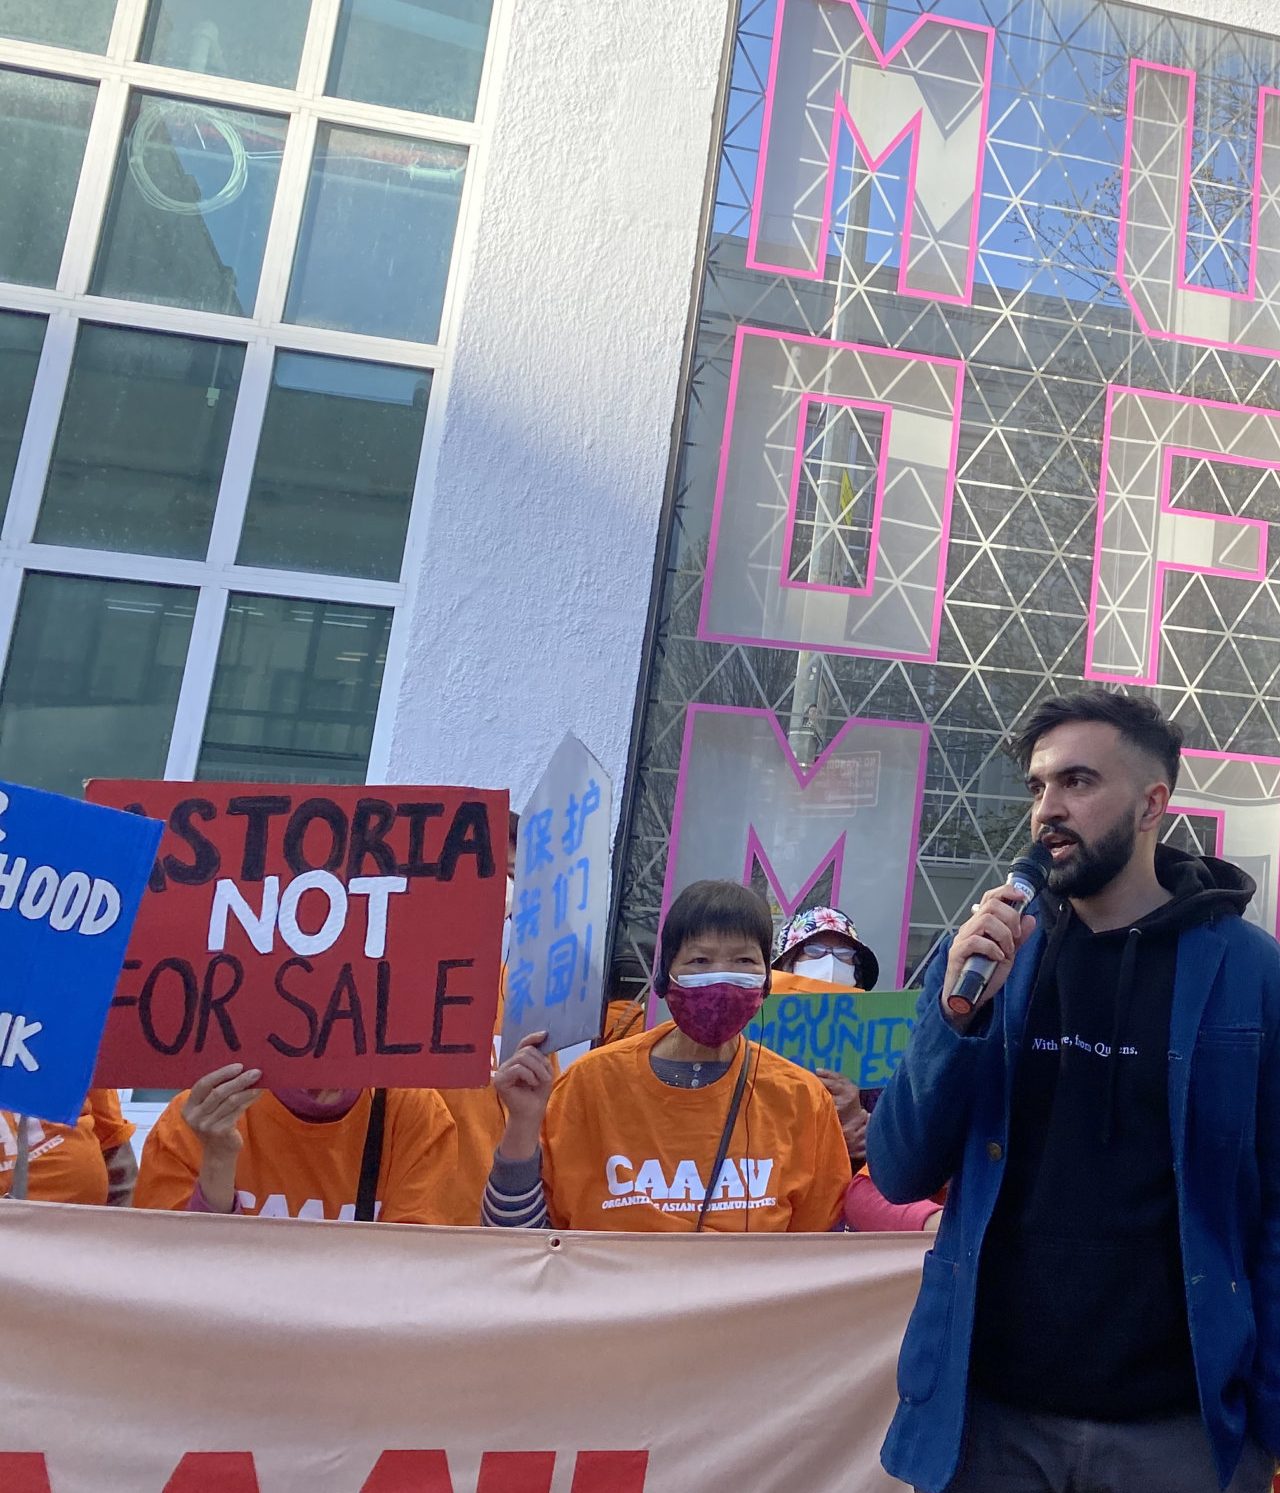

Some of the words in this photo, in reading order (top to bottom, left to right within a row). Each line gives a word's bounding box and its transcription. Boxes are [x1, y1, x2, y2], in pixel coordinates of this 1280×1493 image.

[207, 869, 406, 958] NOT
[267, 957, 475, 1058] SALE
[777, 993, 859, 1024] OUR
[606, 1155, 774, 1200] CAAAV
[662, 1203, 695, 1212] ASIAN
